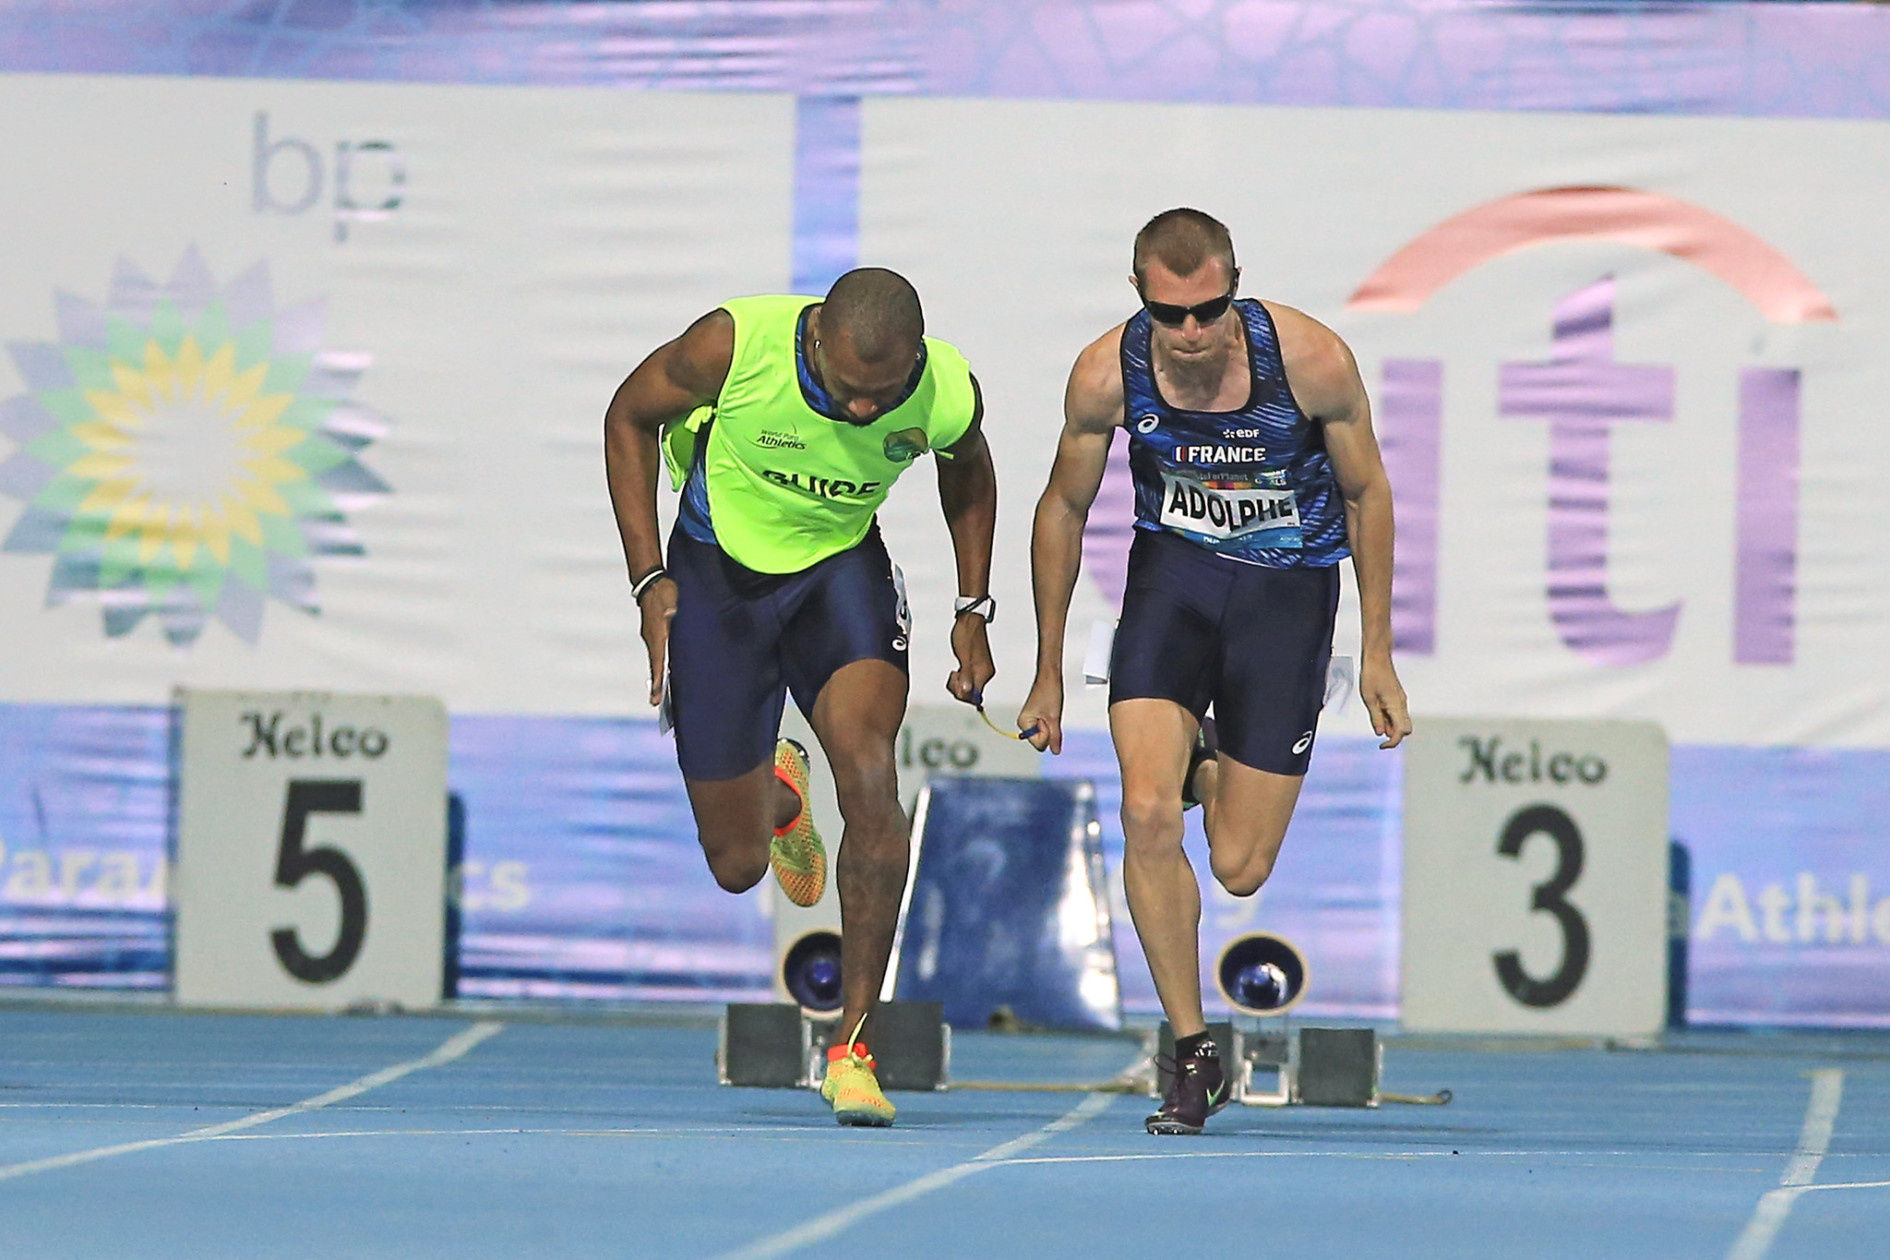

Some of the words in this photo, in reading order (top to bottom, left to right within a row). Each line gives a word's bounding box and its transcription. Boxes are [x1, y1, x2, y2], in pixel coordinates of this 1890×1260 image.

[251, 111, 407, 243] bp
[756, 435, 807, 450] Athletics
[1187, 446, 1267, 463] FRANCE
[1168, 480, 1294, 533] ADOLPHE
[240, 711, 390, 760] Nelco
[1457, 733, 1608, 786] Nelco
[268, 778, 369, 986] 5
[1492, 801, 1591, 1011] 3
